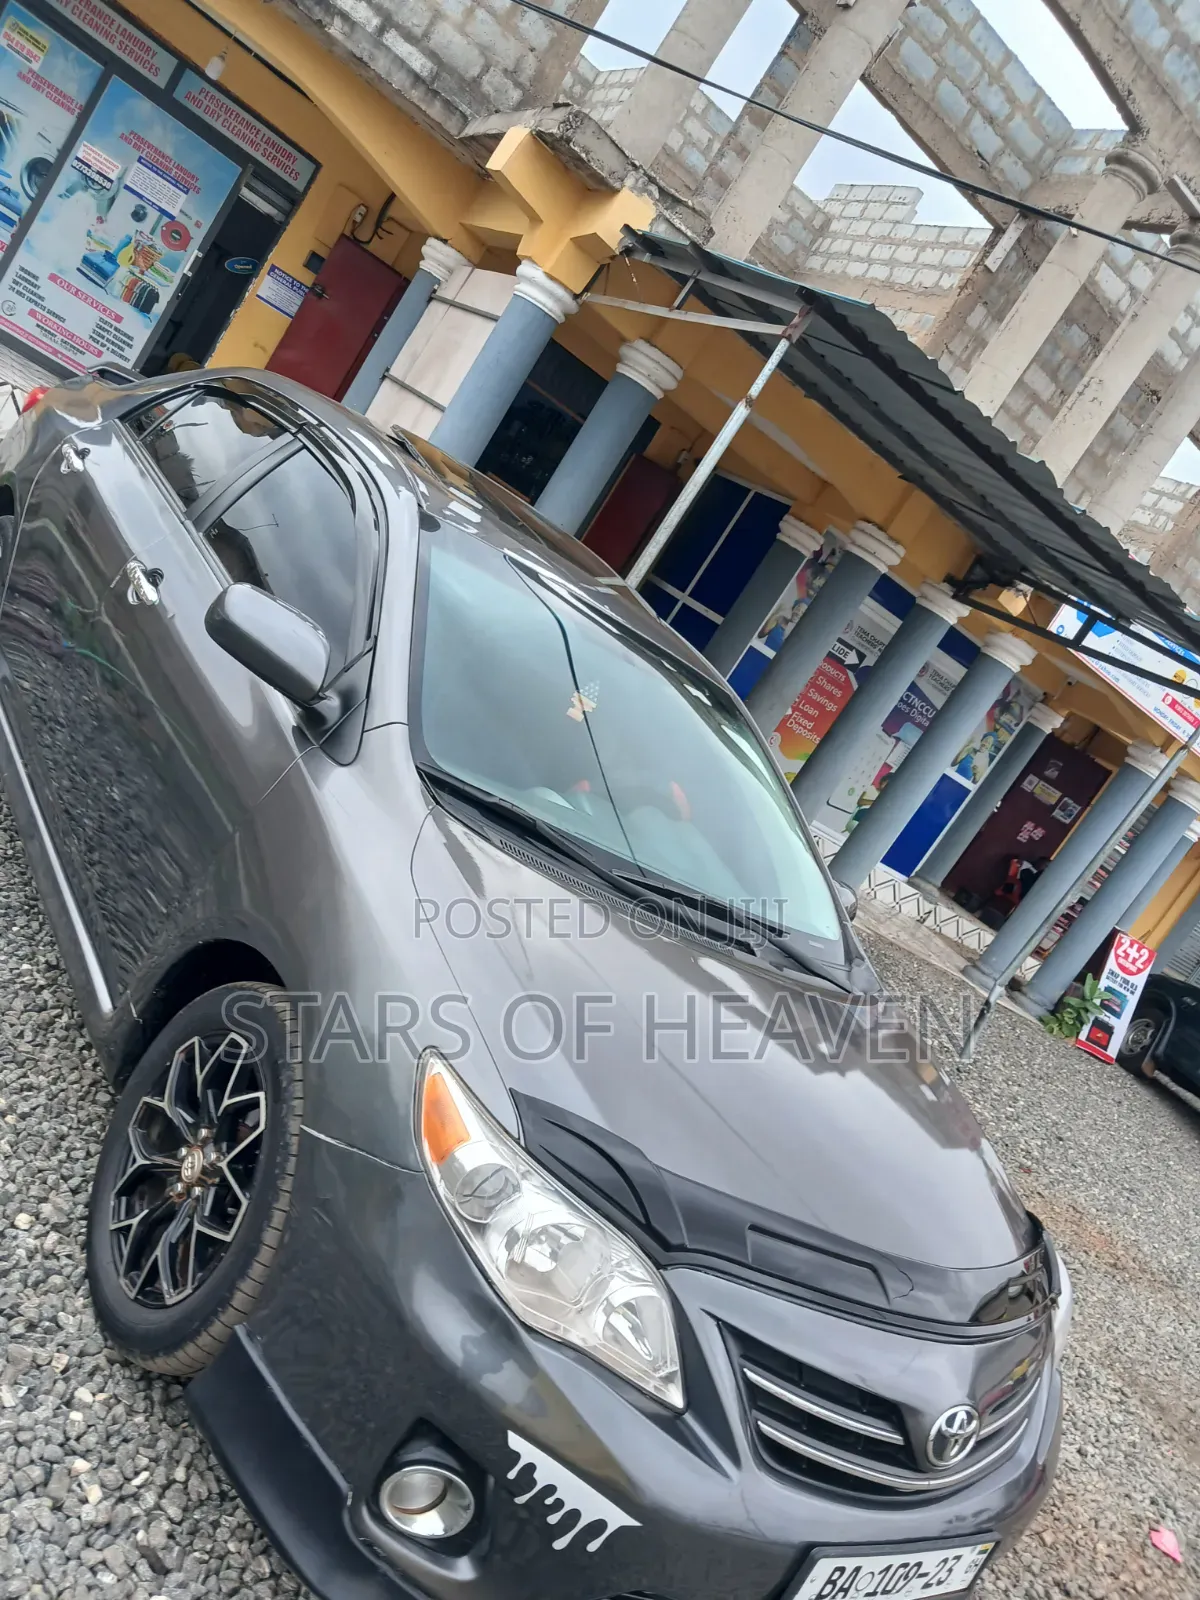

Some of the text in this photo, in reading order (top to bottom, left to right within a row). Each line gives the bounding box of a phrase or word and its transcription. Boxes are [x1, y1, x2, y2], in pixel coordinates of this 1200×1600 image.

[68, 4, 118, 44] CLEANING
[114, 38, 162, 78] SERVICES
[75, 0, 158, 60] ERANCE LANUDRY
[16, 70, 32, 84] AND
[30, 80, 45, 94] DRY
[44, 90, 76, 116] CLEANING
[26, 67, 76, 106] PERSEVERANCE
[183, 90, 301, 181] AND DRY CLEANING SERVICES
[197, 86, 298, 166] PERSEVERANCE LANUDRY
[128, 129, 174, 165] PERSEVERANCE
[118, 132, 133, 145] AND
[131, 141, 145, 154] DRY
[144, 150, 174, 174] CLEANING
[172, 170, 202, 194] SERVICES
[55, 277, 117, 320] OUR SERVICES
[292, 286, 305, 297] PUBL
[34, 312, 73, 339] WORKING
[72, 335, 99, 355] HOURS
[830, 643, 850, 659] LIDE
[869, 634, 885, 648] CHAPT
[815, 674, 844, 698] Shares
[818, 660, 846, 682] ODUCTS
[798, 699, 820, 718] Loan
[805, 687, 839, 714] Savings
[895, 700, 931, 728] oes Digita
[901, 690, 937, 718] CTNCCU
[785, 717, 822, 746] Deposits
[790, 710, 814, 730] Fixed
[1117, 937, 1148, 969] 2+2
